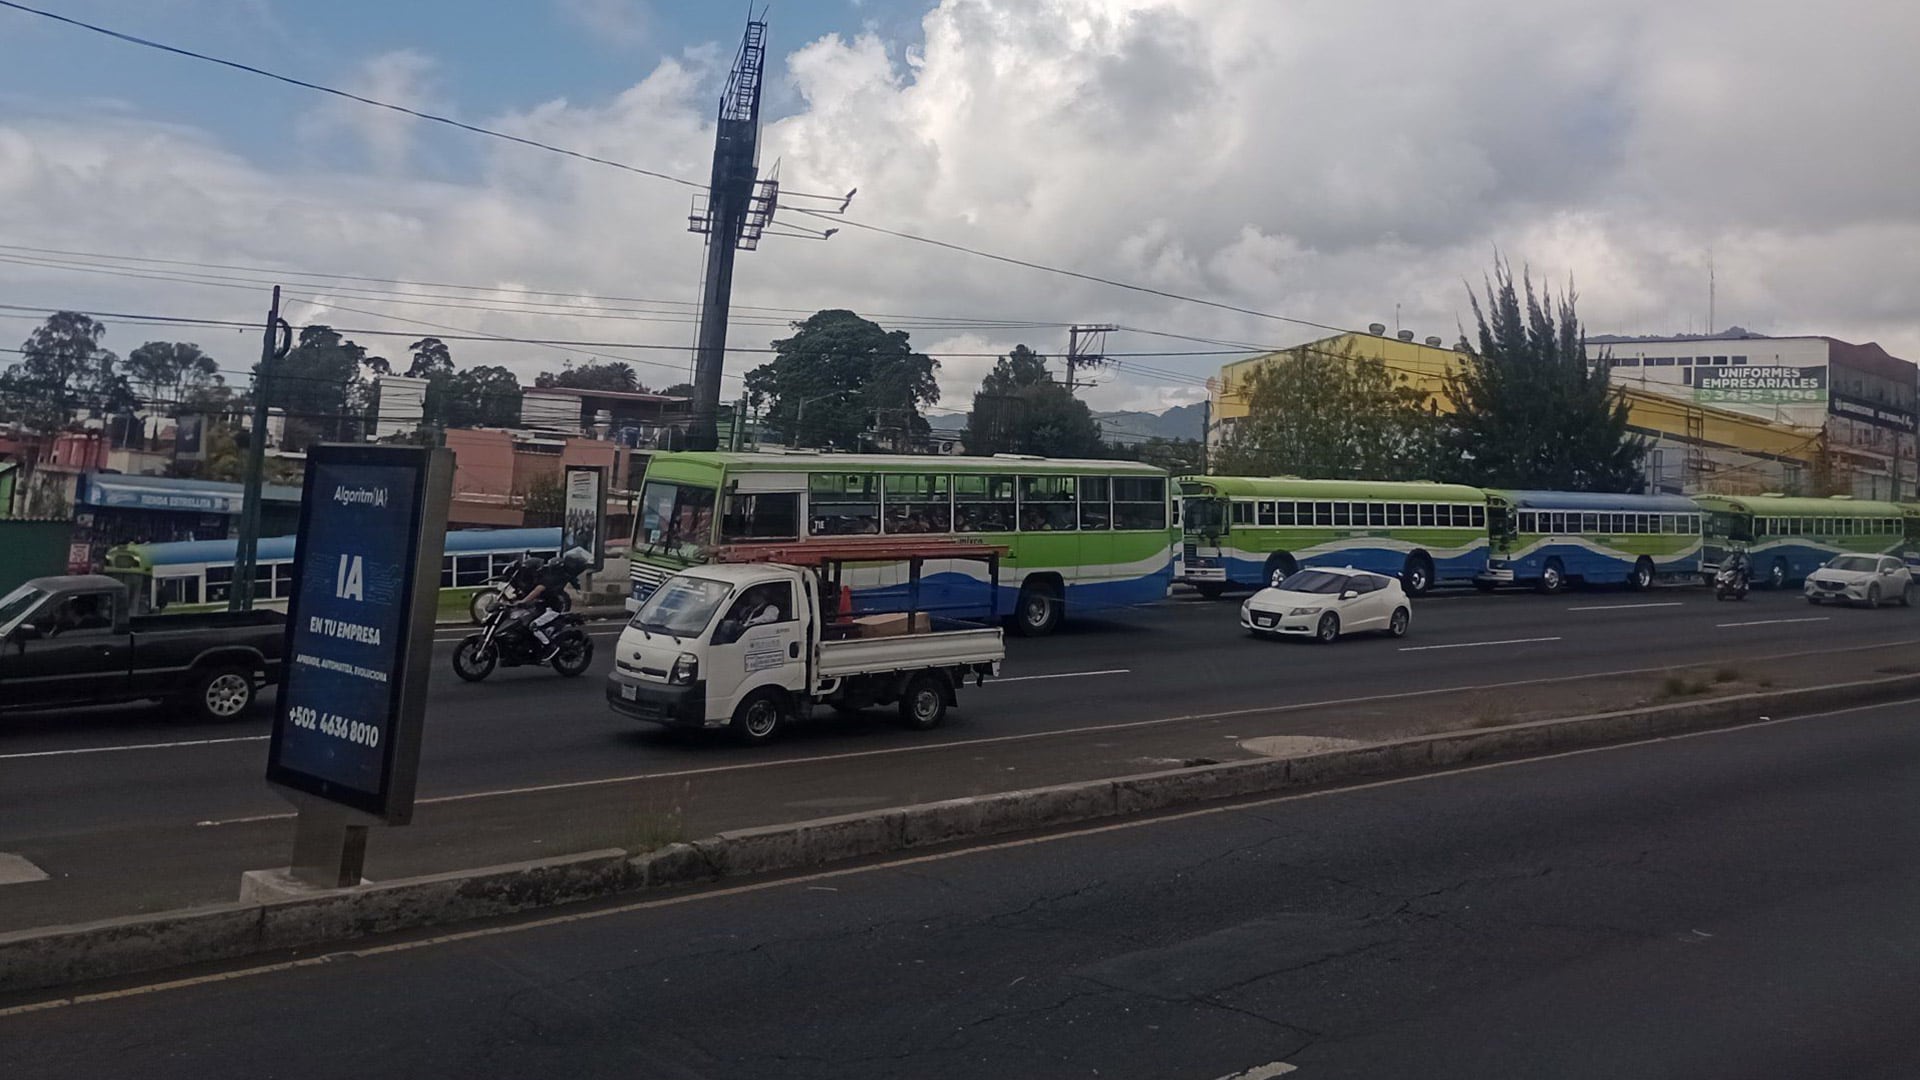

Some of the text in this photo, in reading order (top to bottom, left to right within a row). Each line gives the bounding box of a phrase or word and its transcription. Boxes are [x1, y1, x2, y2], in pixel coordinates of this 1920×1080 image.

[1718, 367, 1801, 378] UNIFORMES
[1702, 378, 1819, 389] EMPRESARIALES
[1714, 389, 1818, 401] 3455-1106
[141, 495, 169, 506] TIENDA
[336, 554, 363, 601] IA
[309, 616, 381, 646] EN TU EMPRESA
[289, 705, 380, 749] +502 4636 8010
